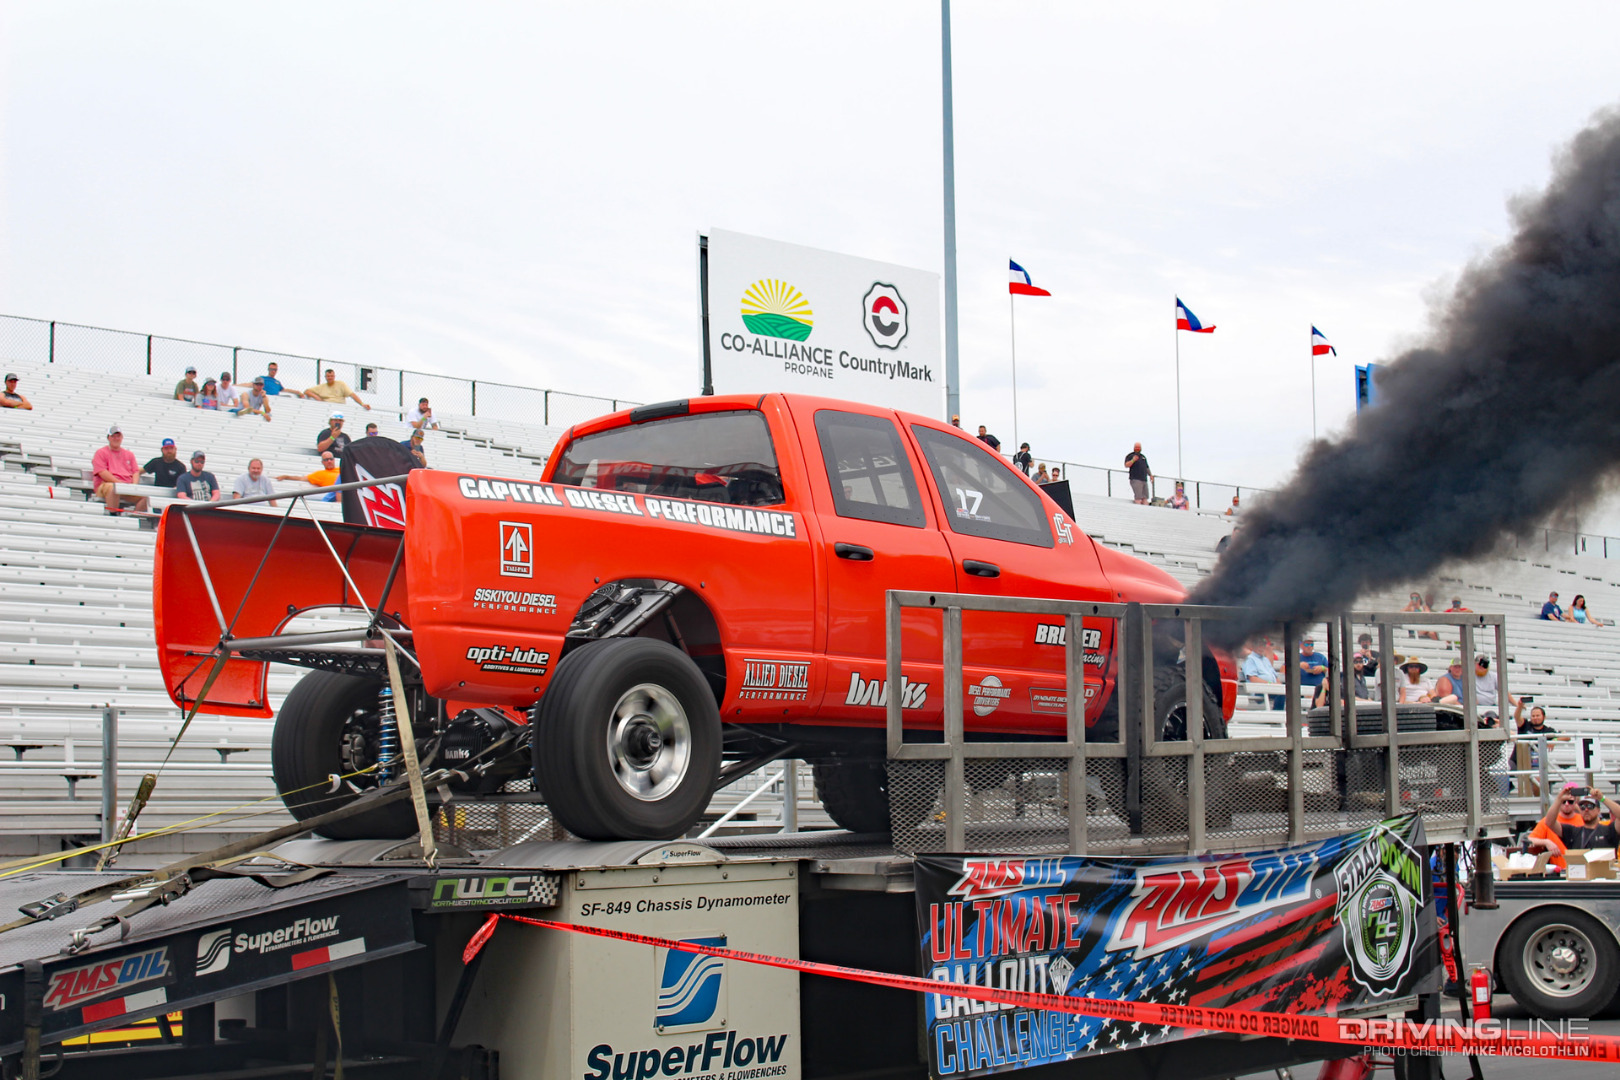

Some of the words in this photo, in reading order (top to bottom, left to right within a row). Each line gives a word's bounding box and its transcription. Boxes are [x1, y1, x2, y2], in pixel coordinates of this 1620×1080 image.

[721, 332, 833, 366] CO-ALLIANCE
[361, 368, 373, 390] F
[785, 362, 834, 379] PROPANE
[839, 350, 932, 383] CountryMark
[458, 477, 563, 506] CAPITAL
[563, 486, 644, 516] DIESEL
[645, 498, 797, 539] PERFORMANCE
[956, 488, 983, 515] 17
[473, 588, 522, 605] SISKIYOU
[522, 592, 557, 608] DIESEL
[473, 602, 557, 615] PERFORMANCE
[466, 645, 550, 666] opti-lube
[1082, 650, 1105, 669] acing
[743, 663, 776, 687] ALLIED
[778, 664, 809, 688] DIESEL
[739, 691, 807, 701] PERFORMANCE
[1582, 738, 1594, 769] F
[669, 849, 701, 858] SuperFlow
[1341, 839, 1380, 903] STRAP
[1379, 834, 1421, 895] DOWN
[947, 857, 1067, 901] AMSOIL
[580, 900, 632, 916] SF-849
[636, 897, 693, 913] Chassis
[697, 893, 791, 911] Dynamometer
[1106, 847, 1320, 960] AMSOIL
[234, 915, 338, 954] SuperFlow
[930, 893, 1081, 962] ULTIMATE
[44, 947, 168, 1011] AMSOIL
[932, 955, 1050, 1019] CALLOUT
[584, 1030, 788, 1080] SuperFlow
[936, 1009, 1077, 1075] CHALLENGE
